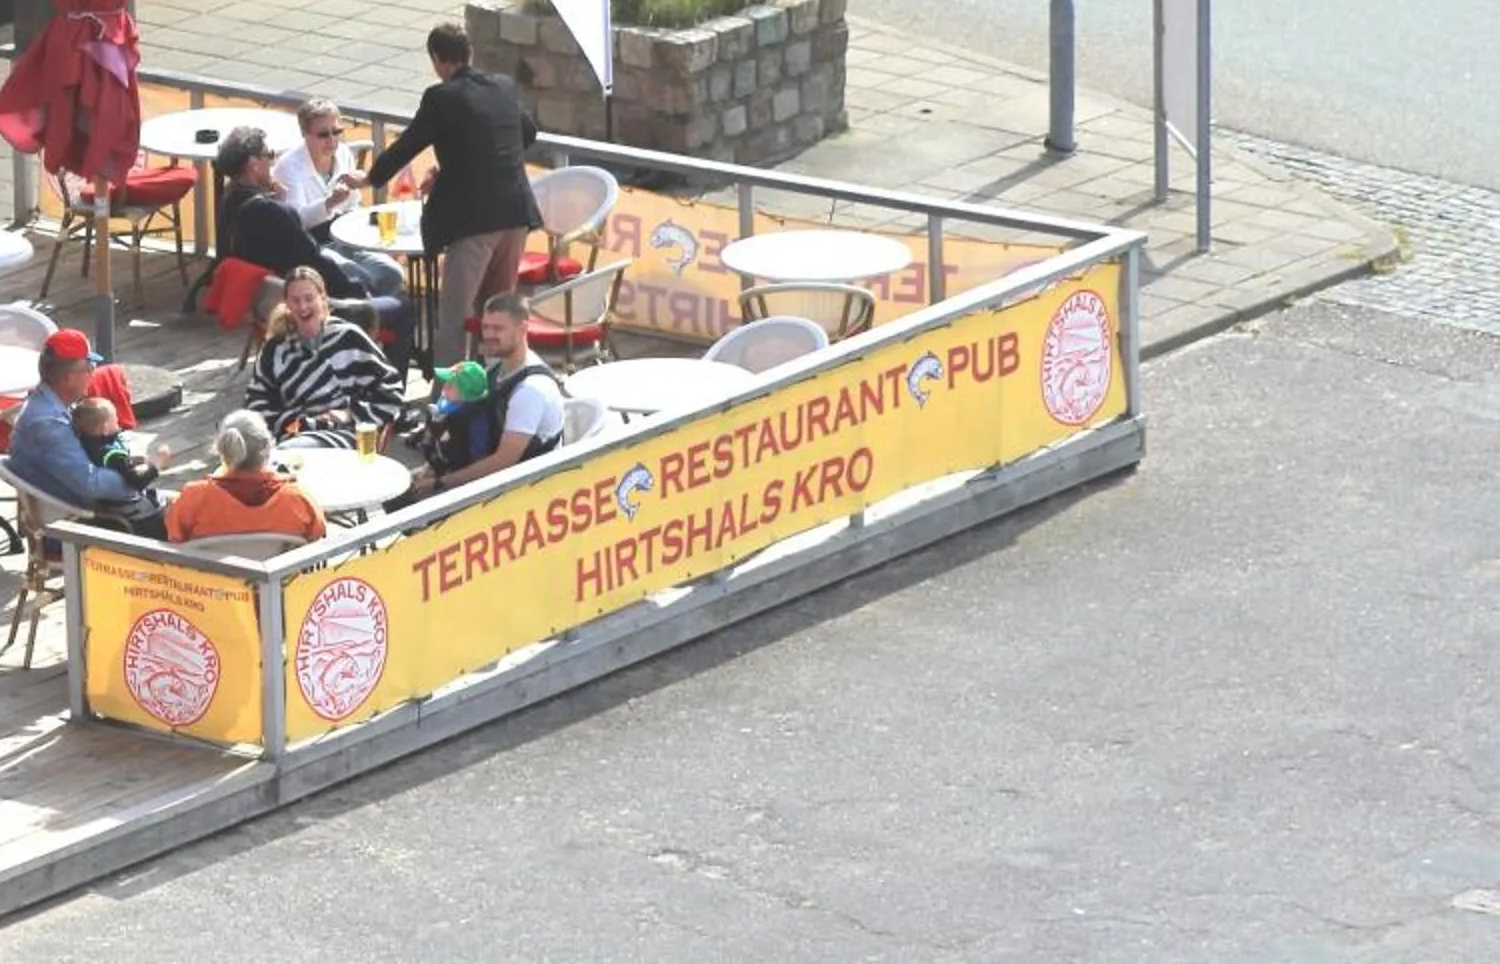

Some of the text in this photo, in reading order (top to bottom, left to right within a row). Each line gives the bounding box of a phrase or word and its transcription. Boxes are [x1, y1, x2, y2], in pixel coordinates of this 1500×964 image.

[412, 331, 1021, 603] TERRASSE RESTAURANT PUB
[575, 447, 875, 603] HIRTSHALS KRO
[128, 613, 217, 684] HIRTSHALS KRO
[299, 582, 385, 671] HIRTSHALS KRO
